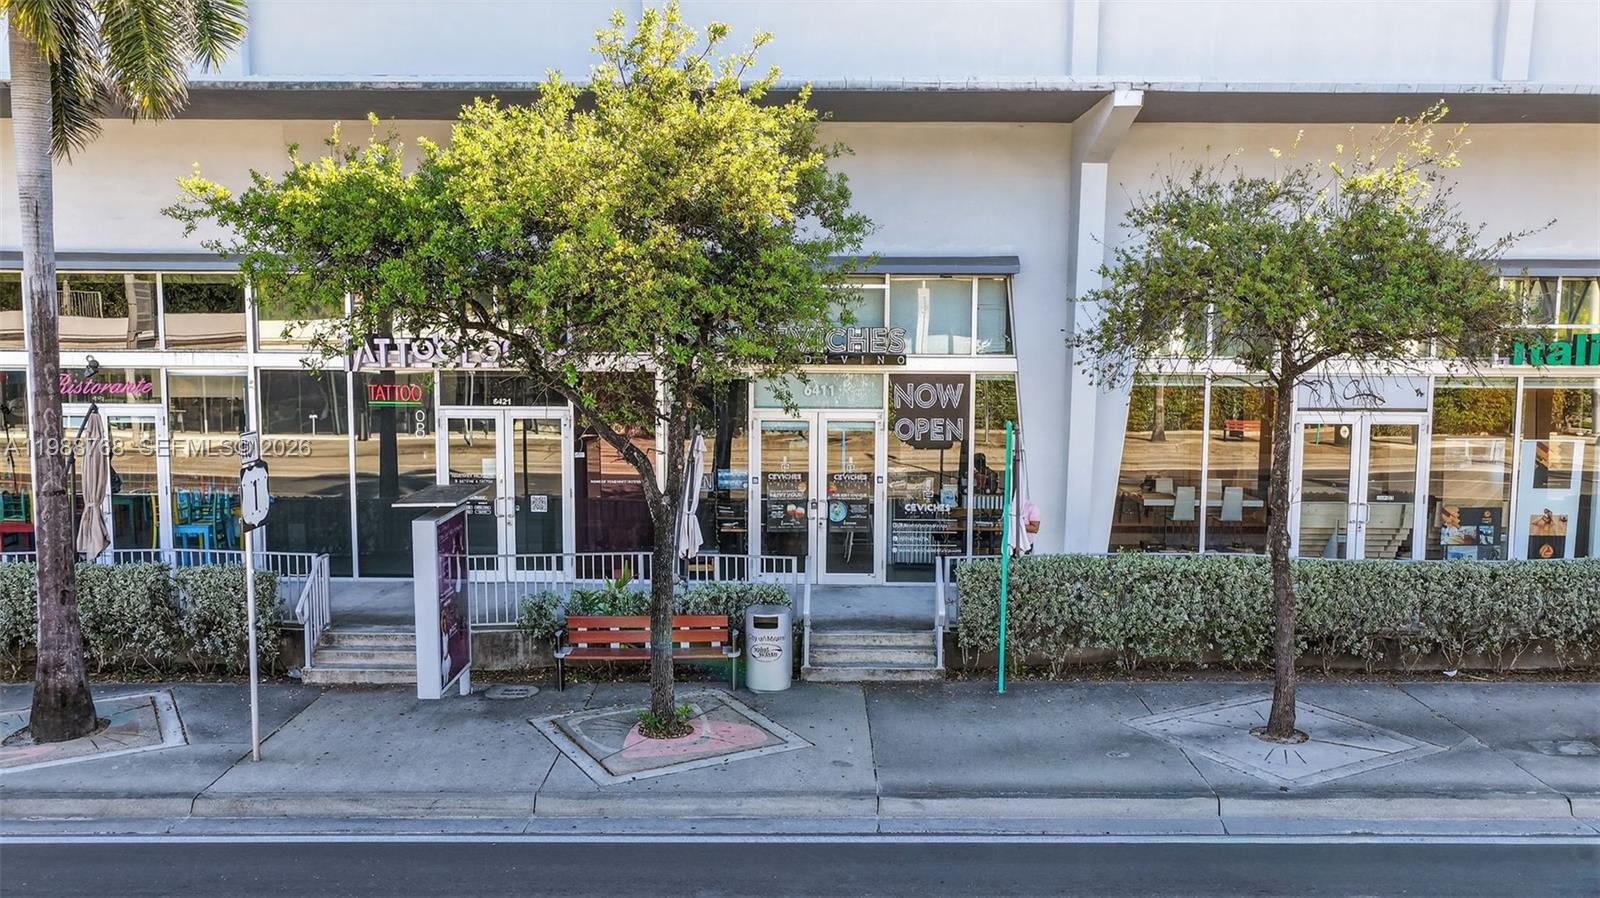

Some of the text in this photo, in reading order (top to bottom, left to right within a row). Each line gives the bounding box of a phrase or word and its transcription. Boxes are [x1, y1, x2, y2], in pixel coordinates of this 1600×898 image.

[59, 373, 153, 395] Ristorante
[368, 384, 423, 401] TATTOO
[803, 384, 835, 397] 6411
[894, 383, 965, 409] NOW
[894, 417, 964, 441] OPEN
[252, 479, 259, 511] 1
[904, 502, 951, 512] CEVICHES
